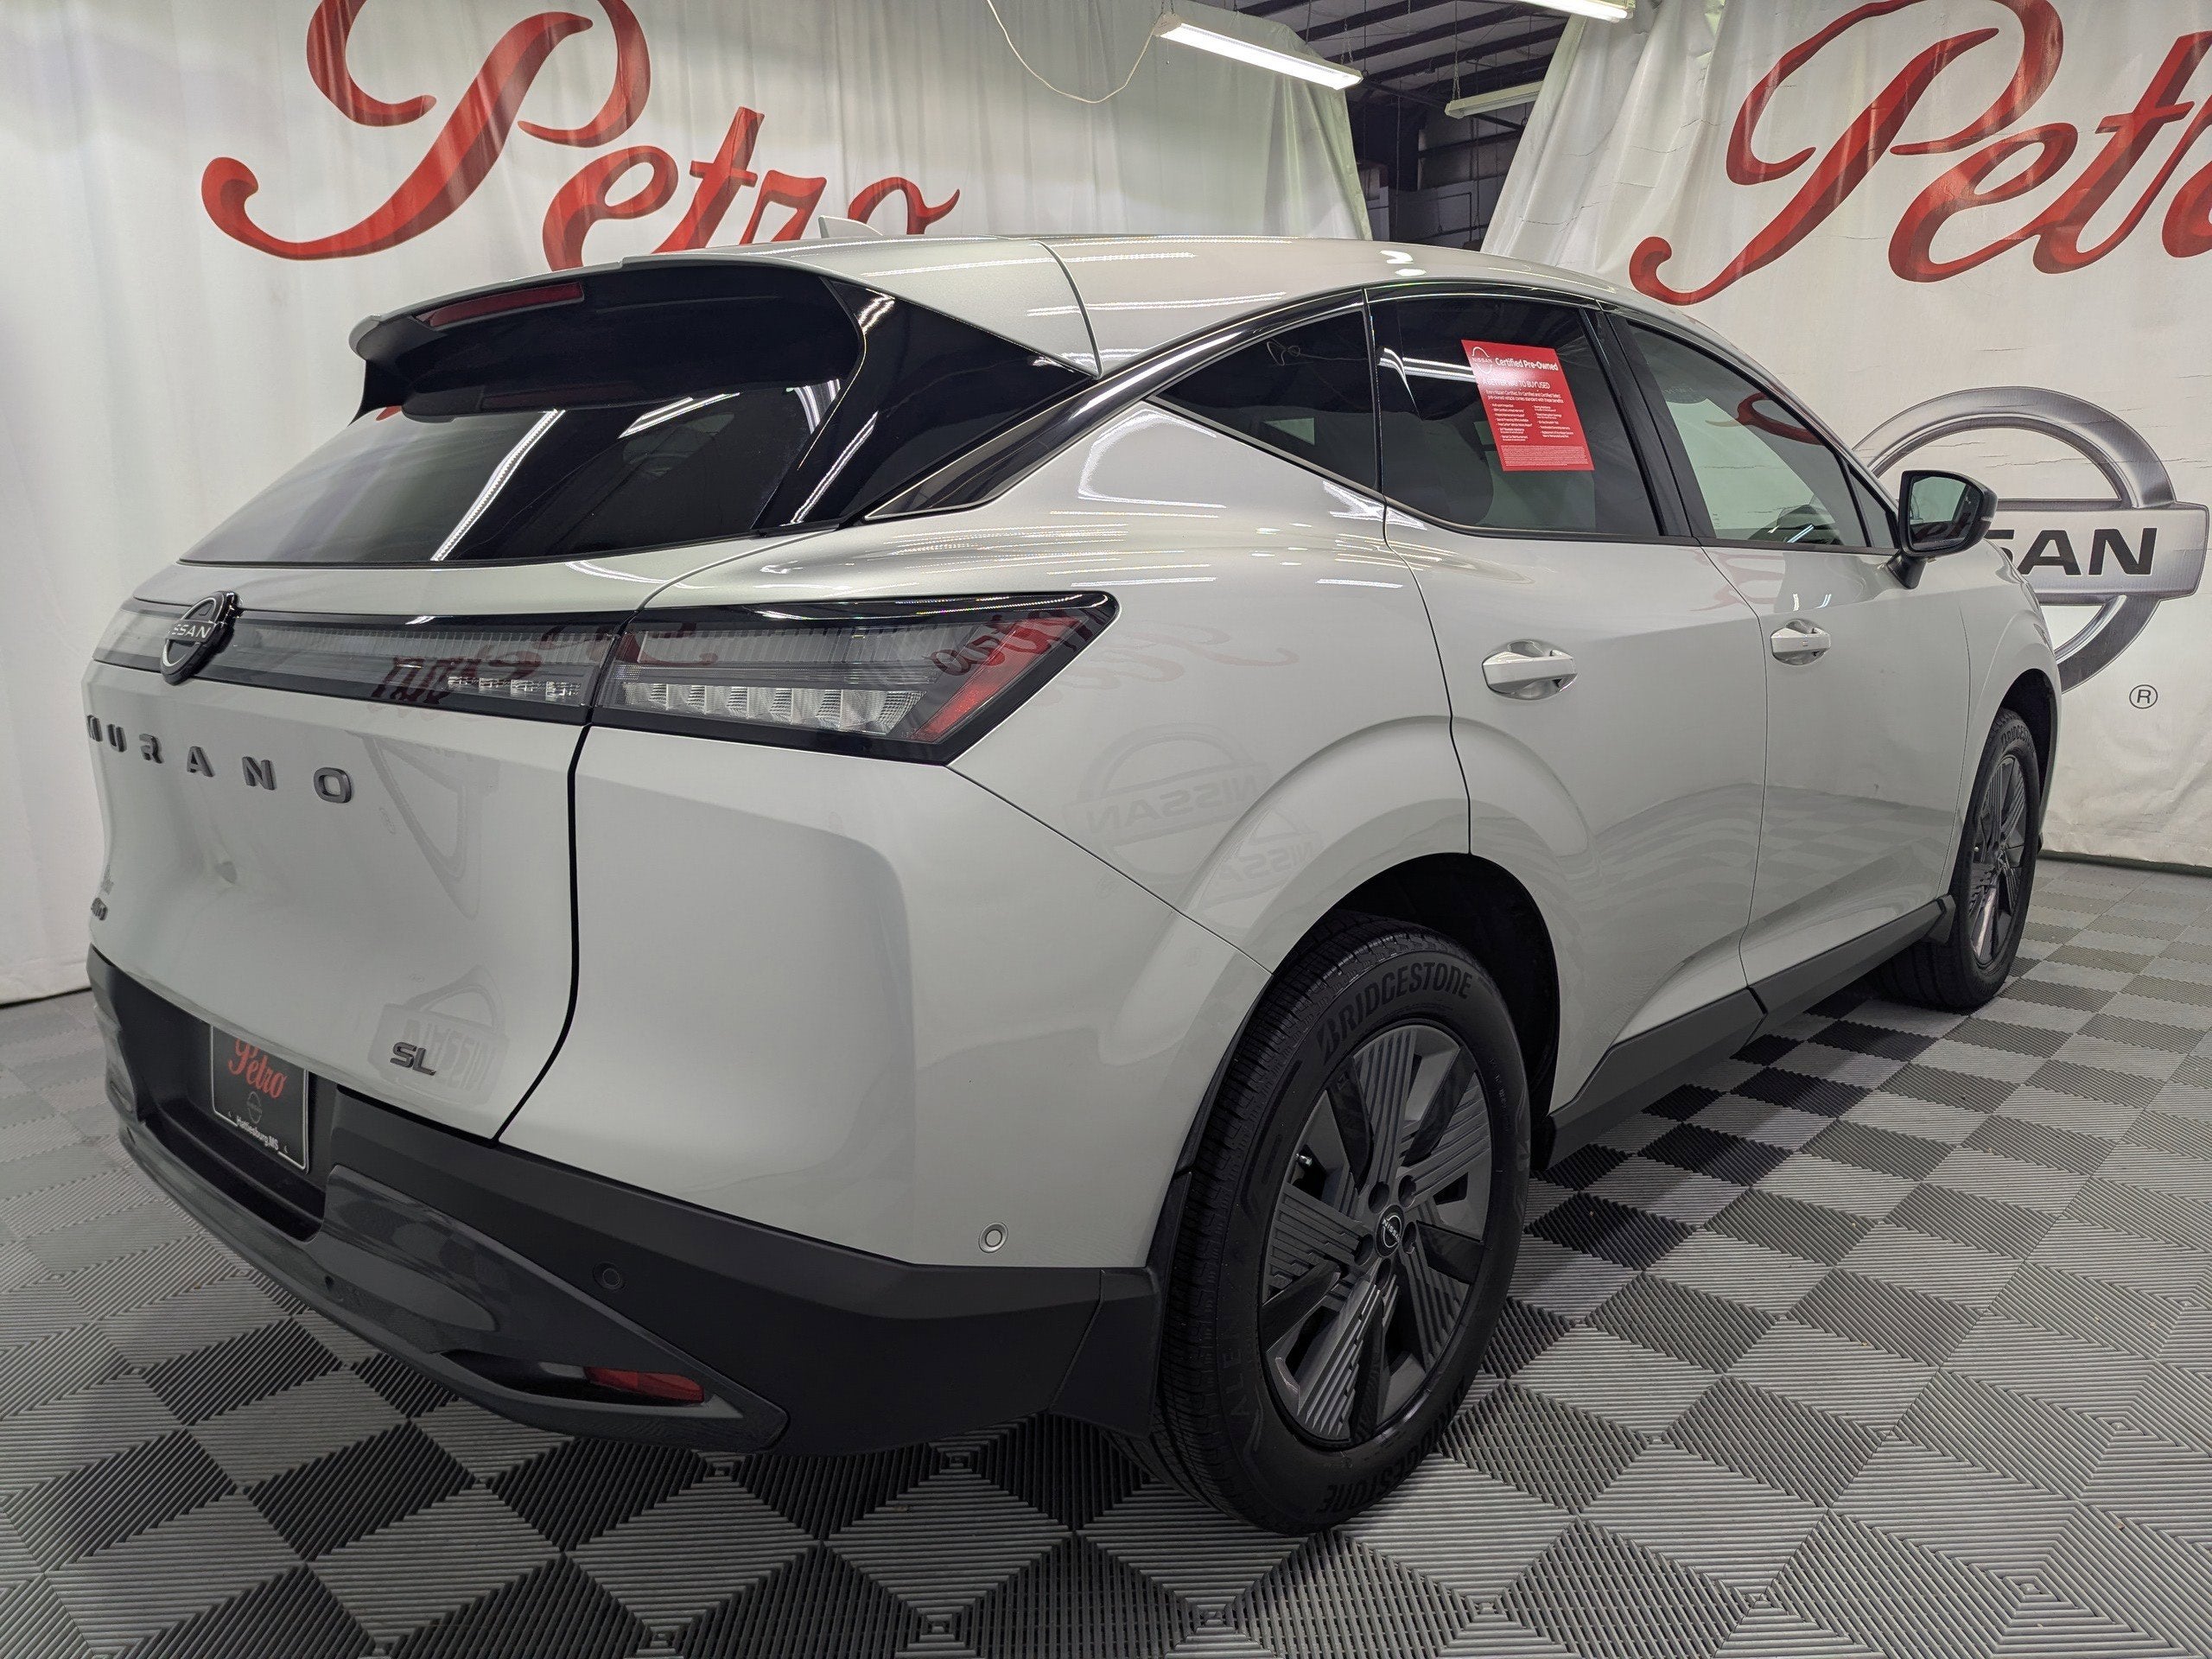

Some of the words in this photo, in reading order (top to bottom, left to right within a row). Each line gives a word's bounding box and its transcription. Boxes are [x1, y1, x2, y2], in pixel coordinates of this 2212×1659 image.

[1495, 357, 1523, 368] Certified
[1523, 360, 1559, 372] Pre-Owned
[1316, 962, 1473, 1067] BRIDGESTONE
[390, 1041, 436, 1077] SL
